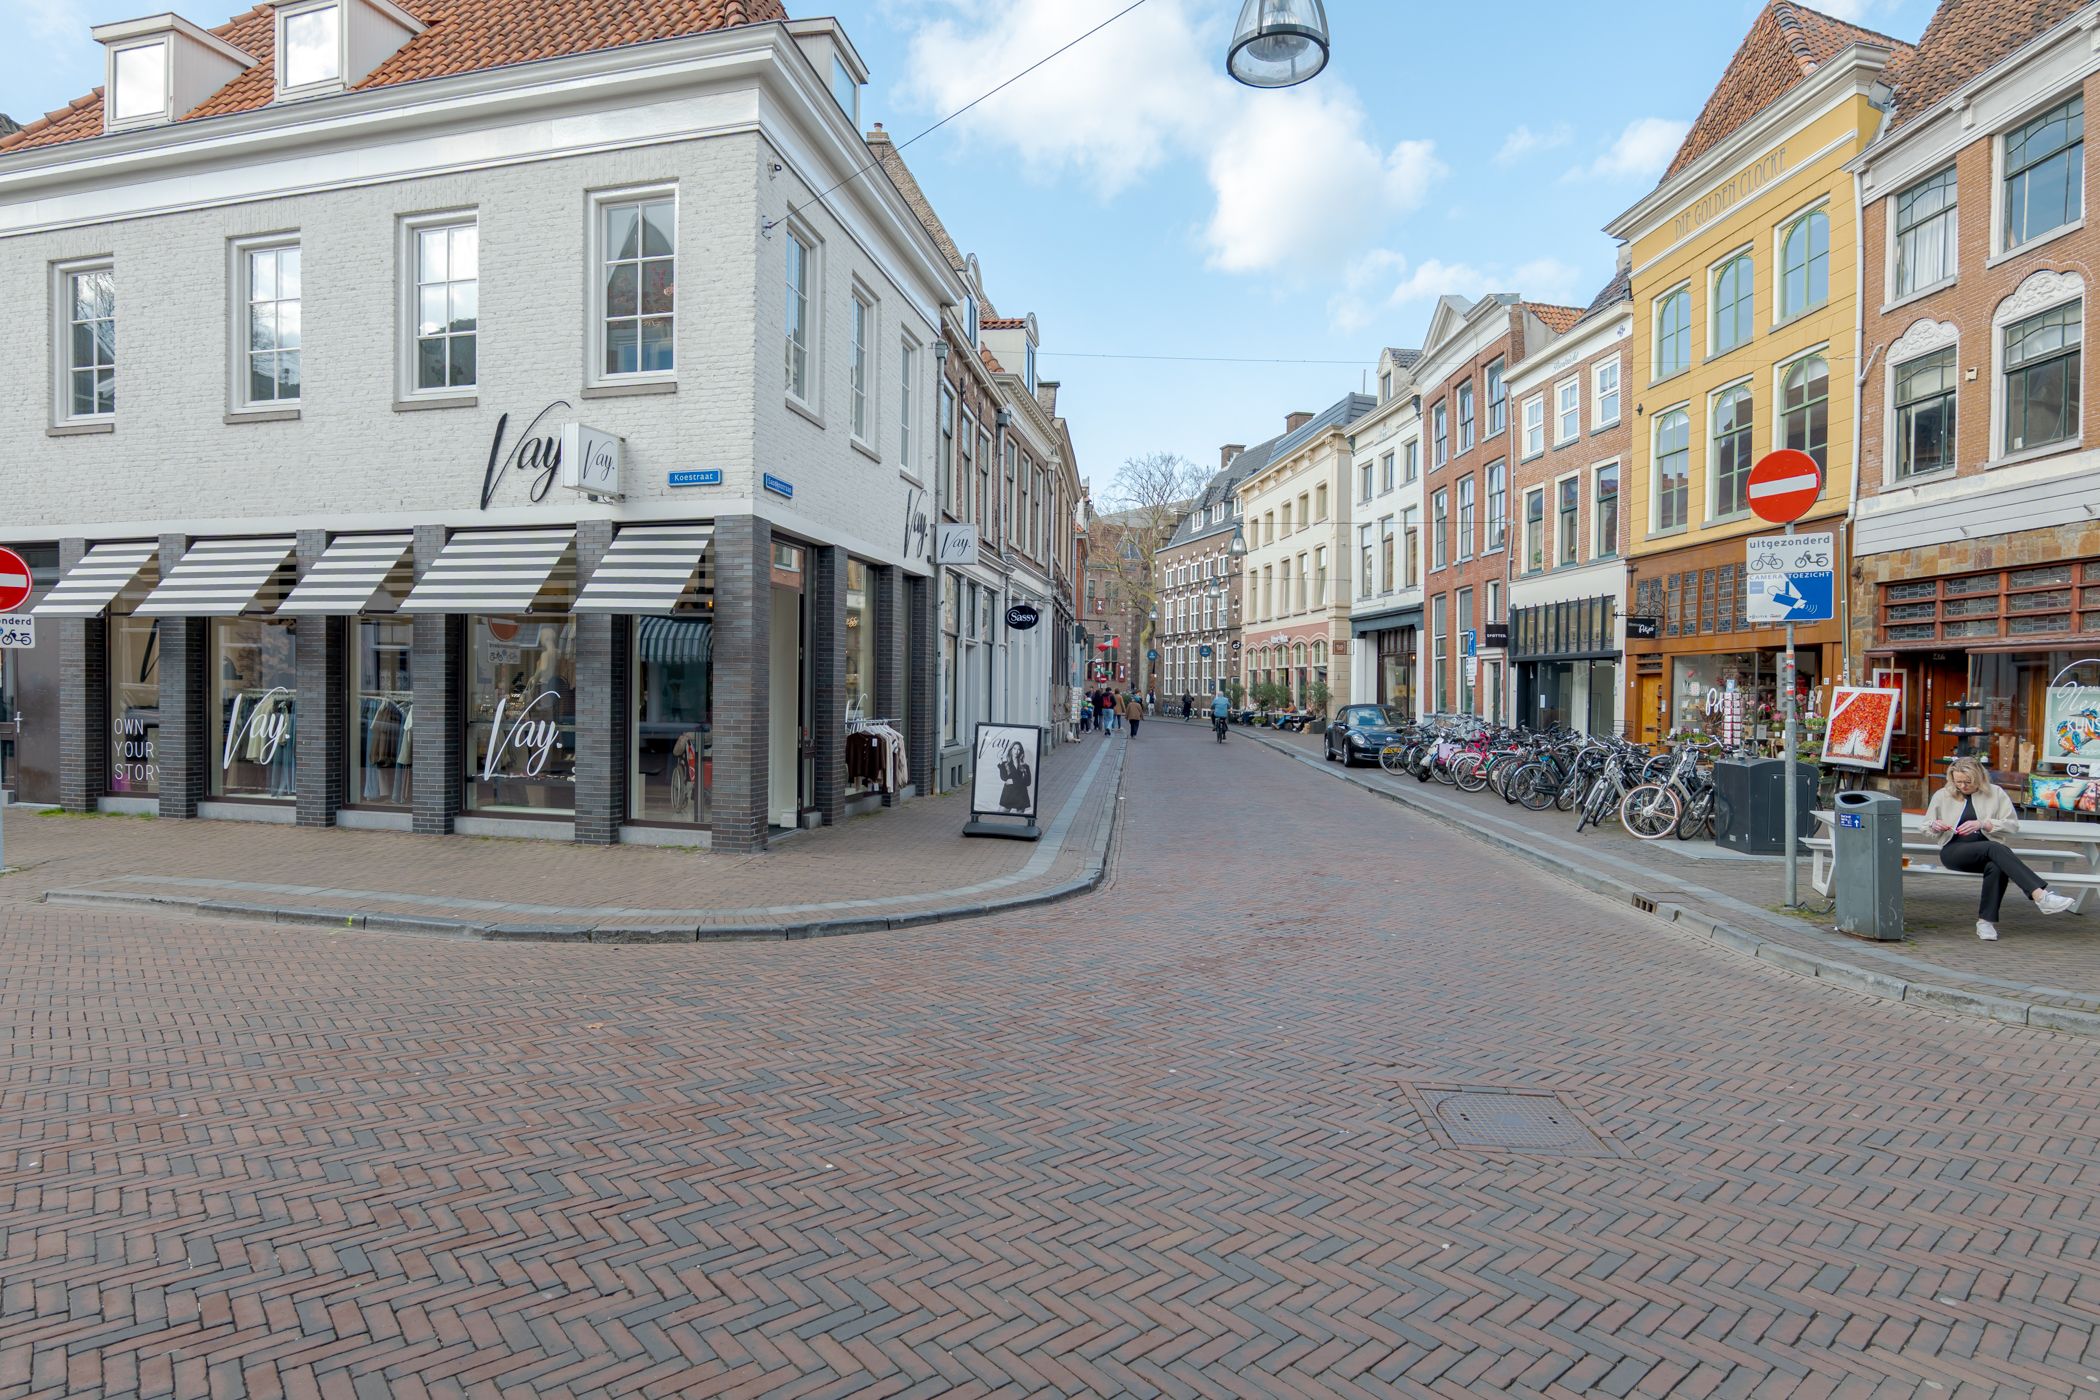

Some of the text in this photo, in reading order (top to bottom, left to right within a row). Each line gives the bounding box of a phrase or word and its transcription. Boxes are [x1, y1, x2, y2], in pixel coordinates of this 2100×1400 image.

[1674, 211, 1691, 241] DIE
[1695, 181, 1736, 226] GOLDEN
[674, 473, 714, 482] Koestraat
[1749, 535, 1831, 549] uitgezonderd
[1788, 571, 1831, 579] TOEZICHT
[0, 618, 32, 626] nderd
[1008, 610, 1037, 625] Sassy
[114, 718, 144, 735] OWN
[223, 686, 291, 770] Vay.
[484, 690, 563, 782] Vay.
[114, 741, 154, 758] YOUR
